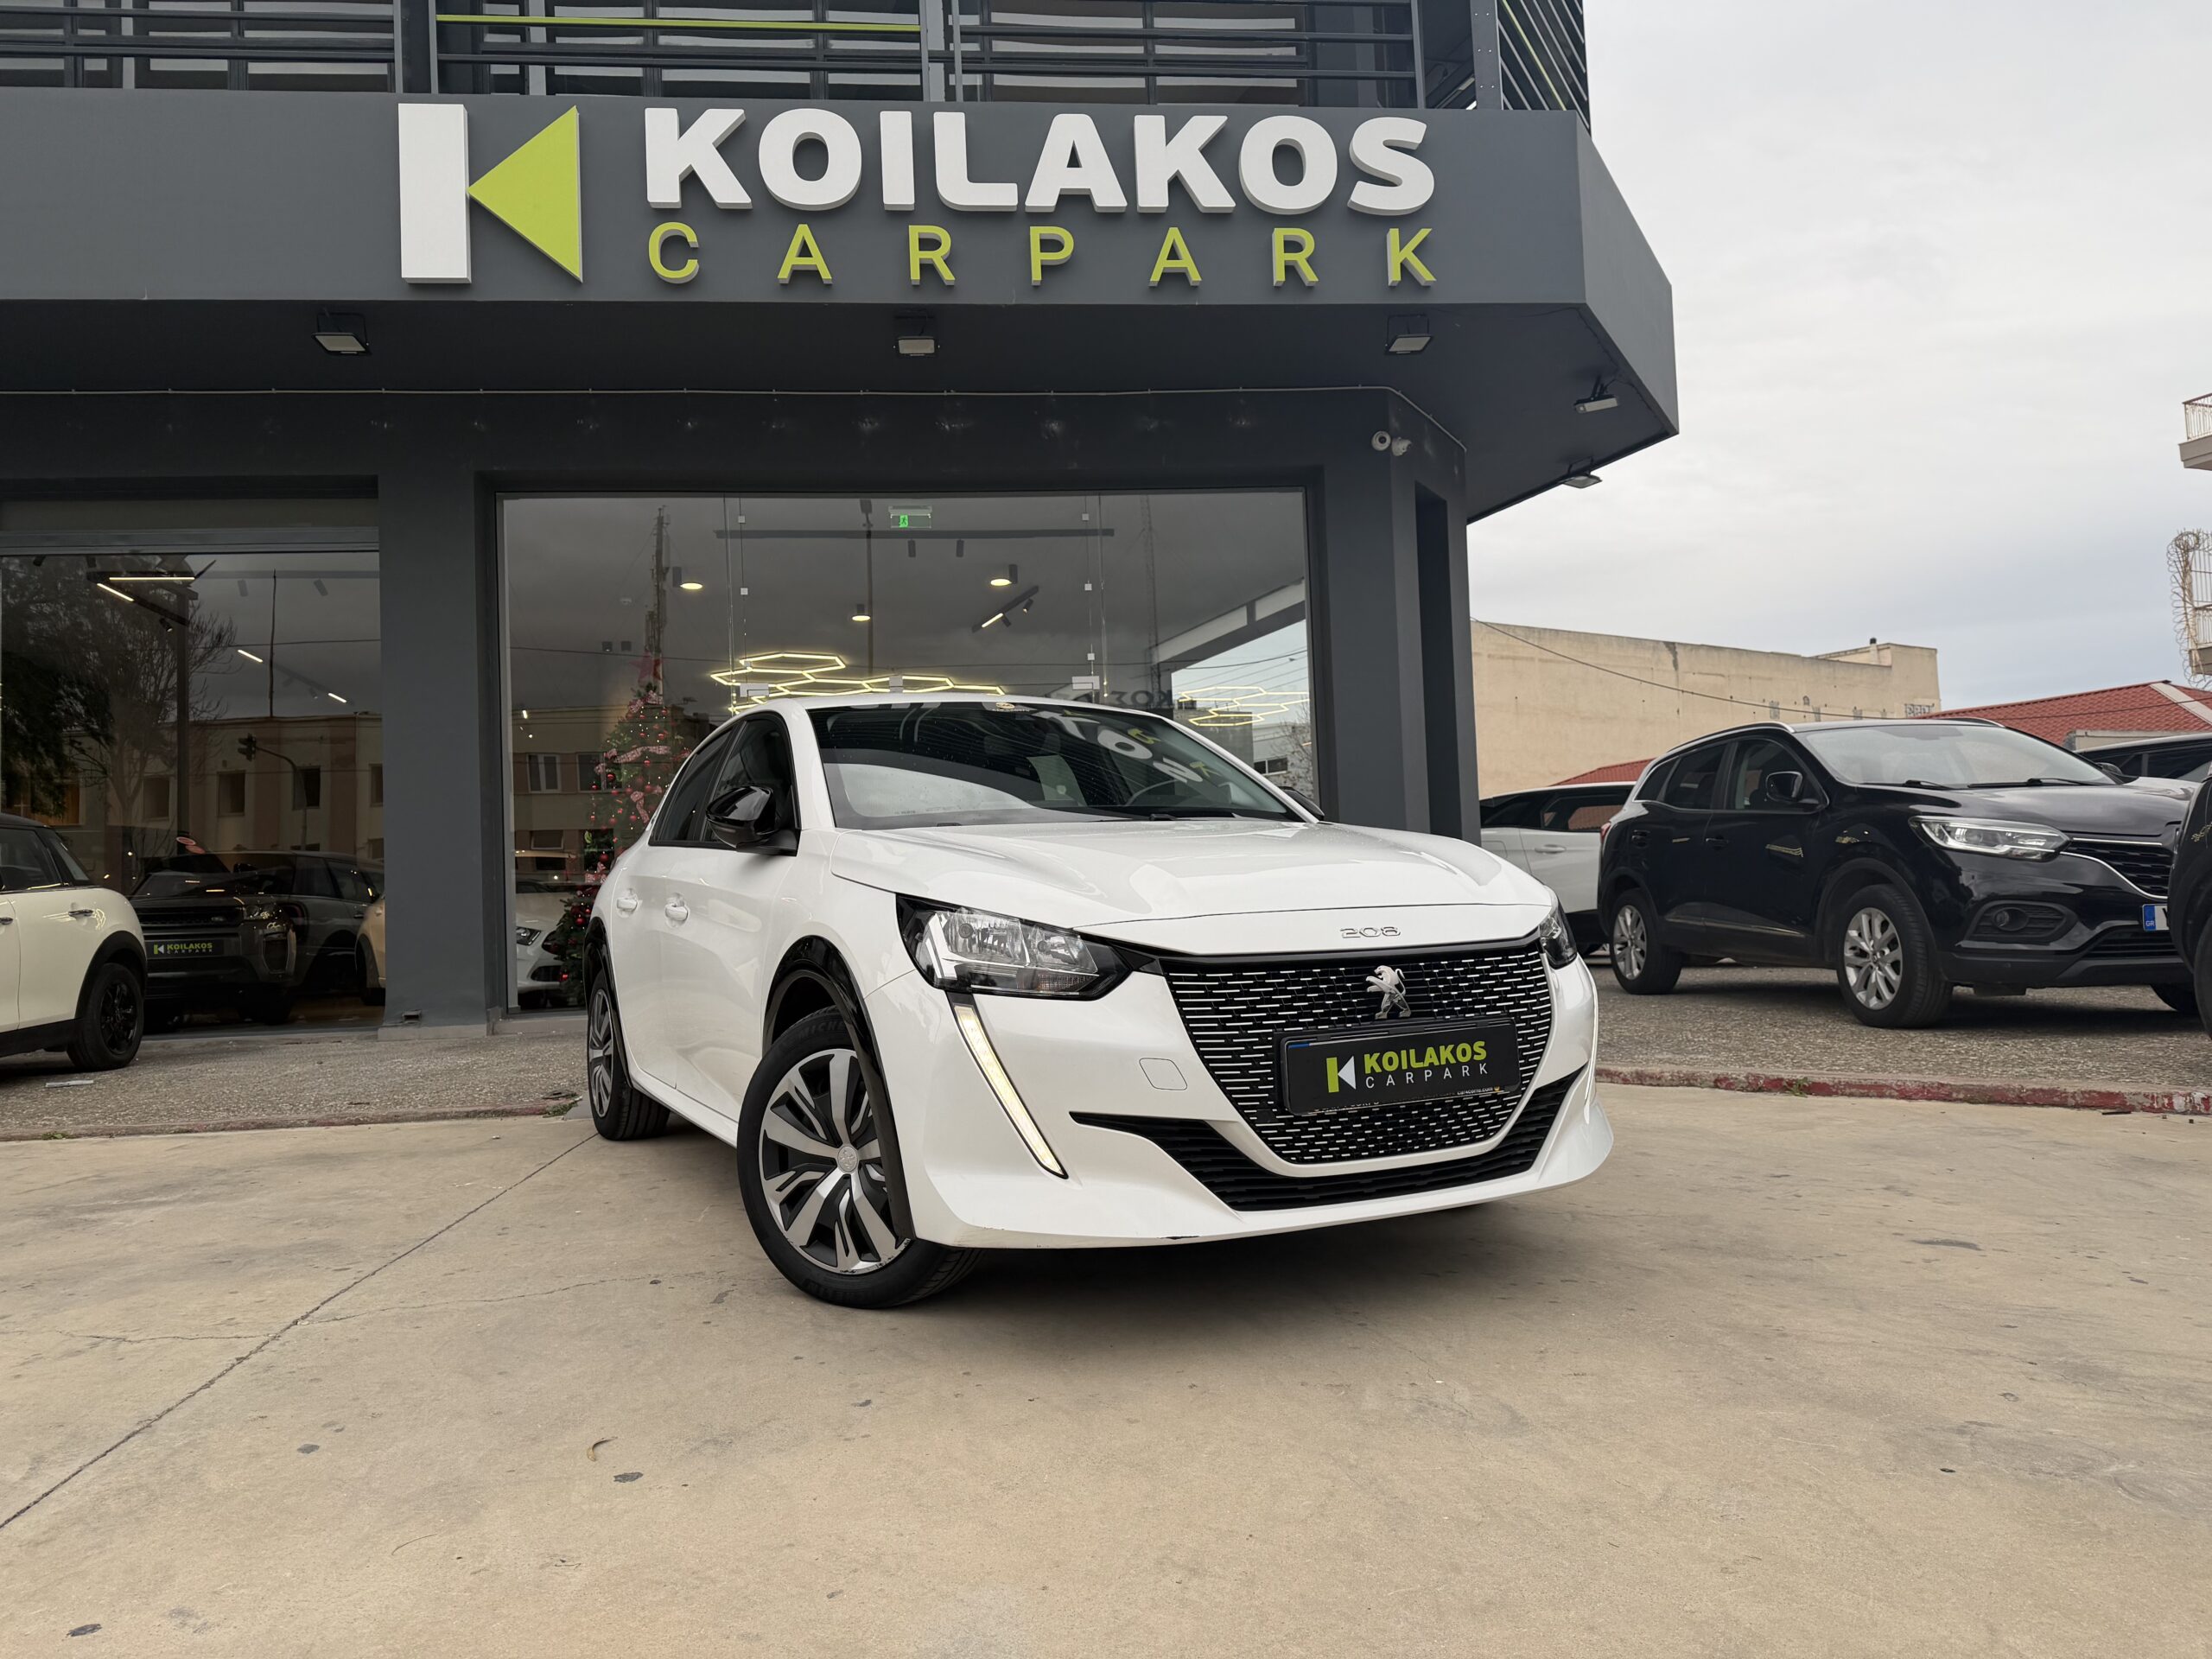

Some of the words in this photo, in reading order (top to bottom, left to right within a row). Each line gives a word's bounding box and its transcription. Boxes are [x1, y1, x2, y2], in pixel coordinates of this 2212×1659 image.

[644, 107, 1435, 215] KOILAKOS
[648, 221, 1437, 287] CARPARK
[1340, 925, 1402, 939] 208
[1363, 1040, 1487, 1075] KOILAKOS
[1365, 1063, 1488, 1090] CARPARK
